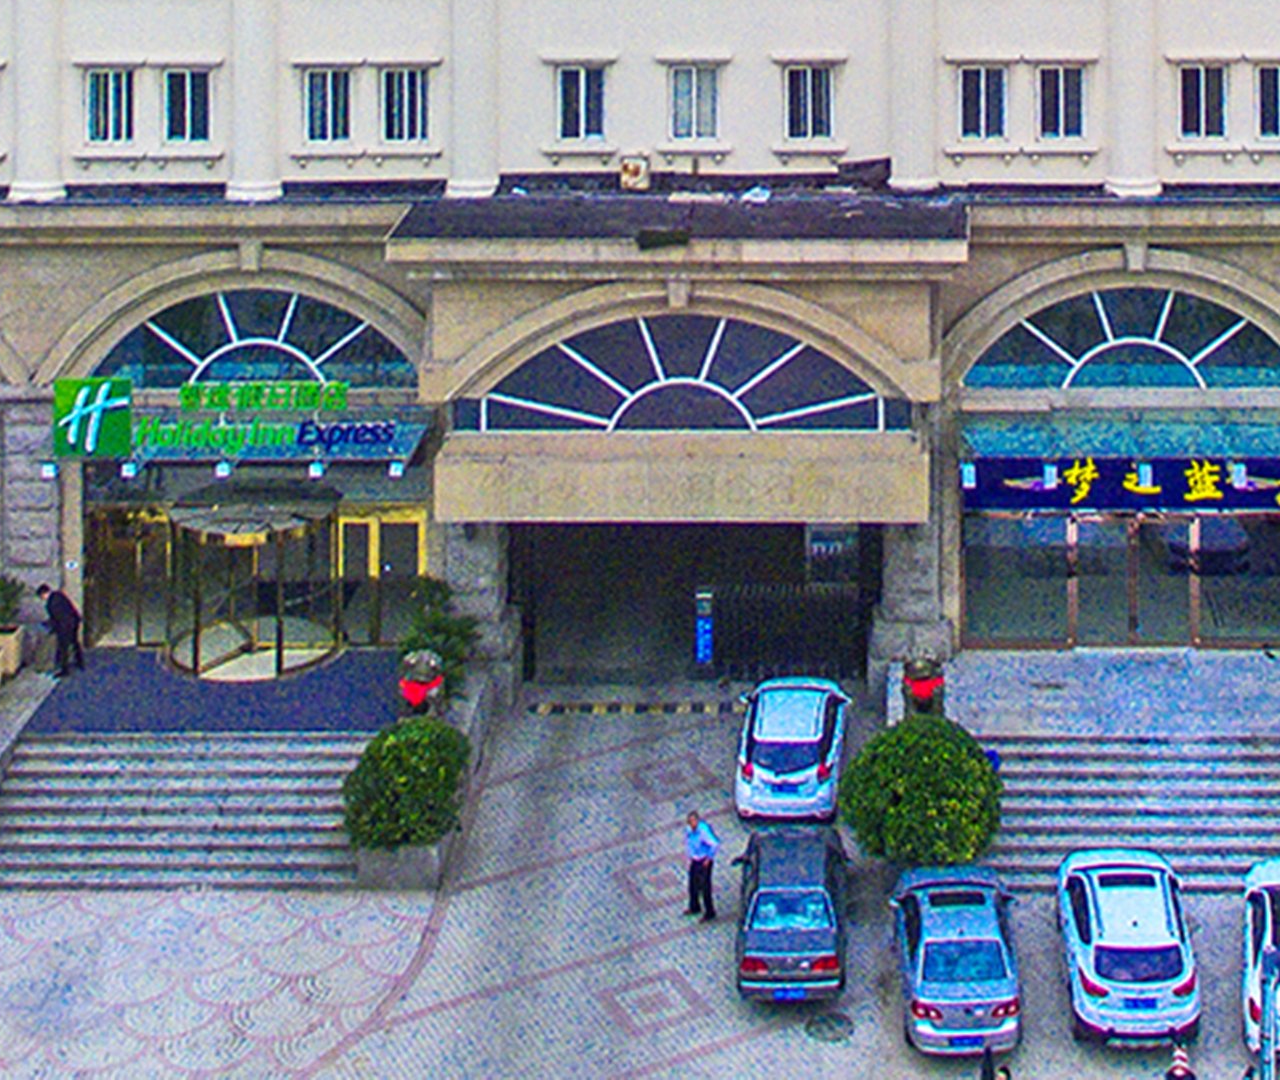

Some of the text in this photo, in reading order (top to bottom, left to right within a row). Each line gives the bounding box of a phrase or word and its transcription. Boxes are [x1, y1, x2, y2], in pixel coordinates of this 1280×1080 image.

[135, 417, 396, 454] Holiday Inn Express
